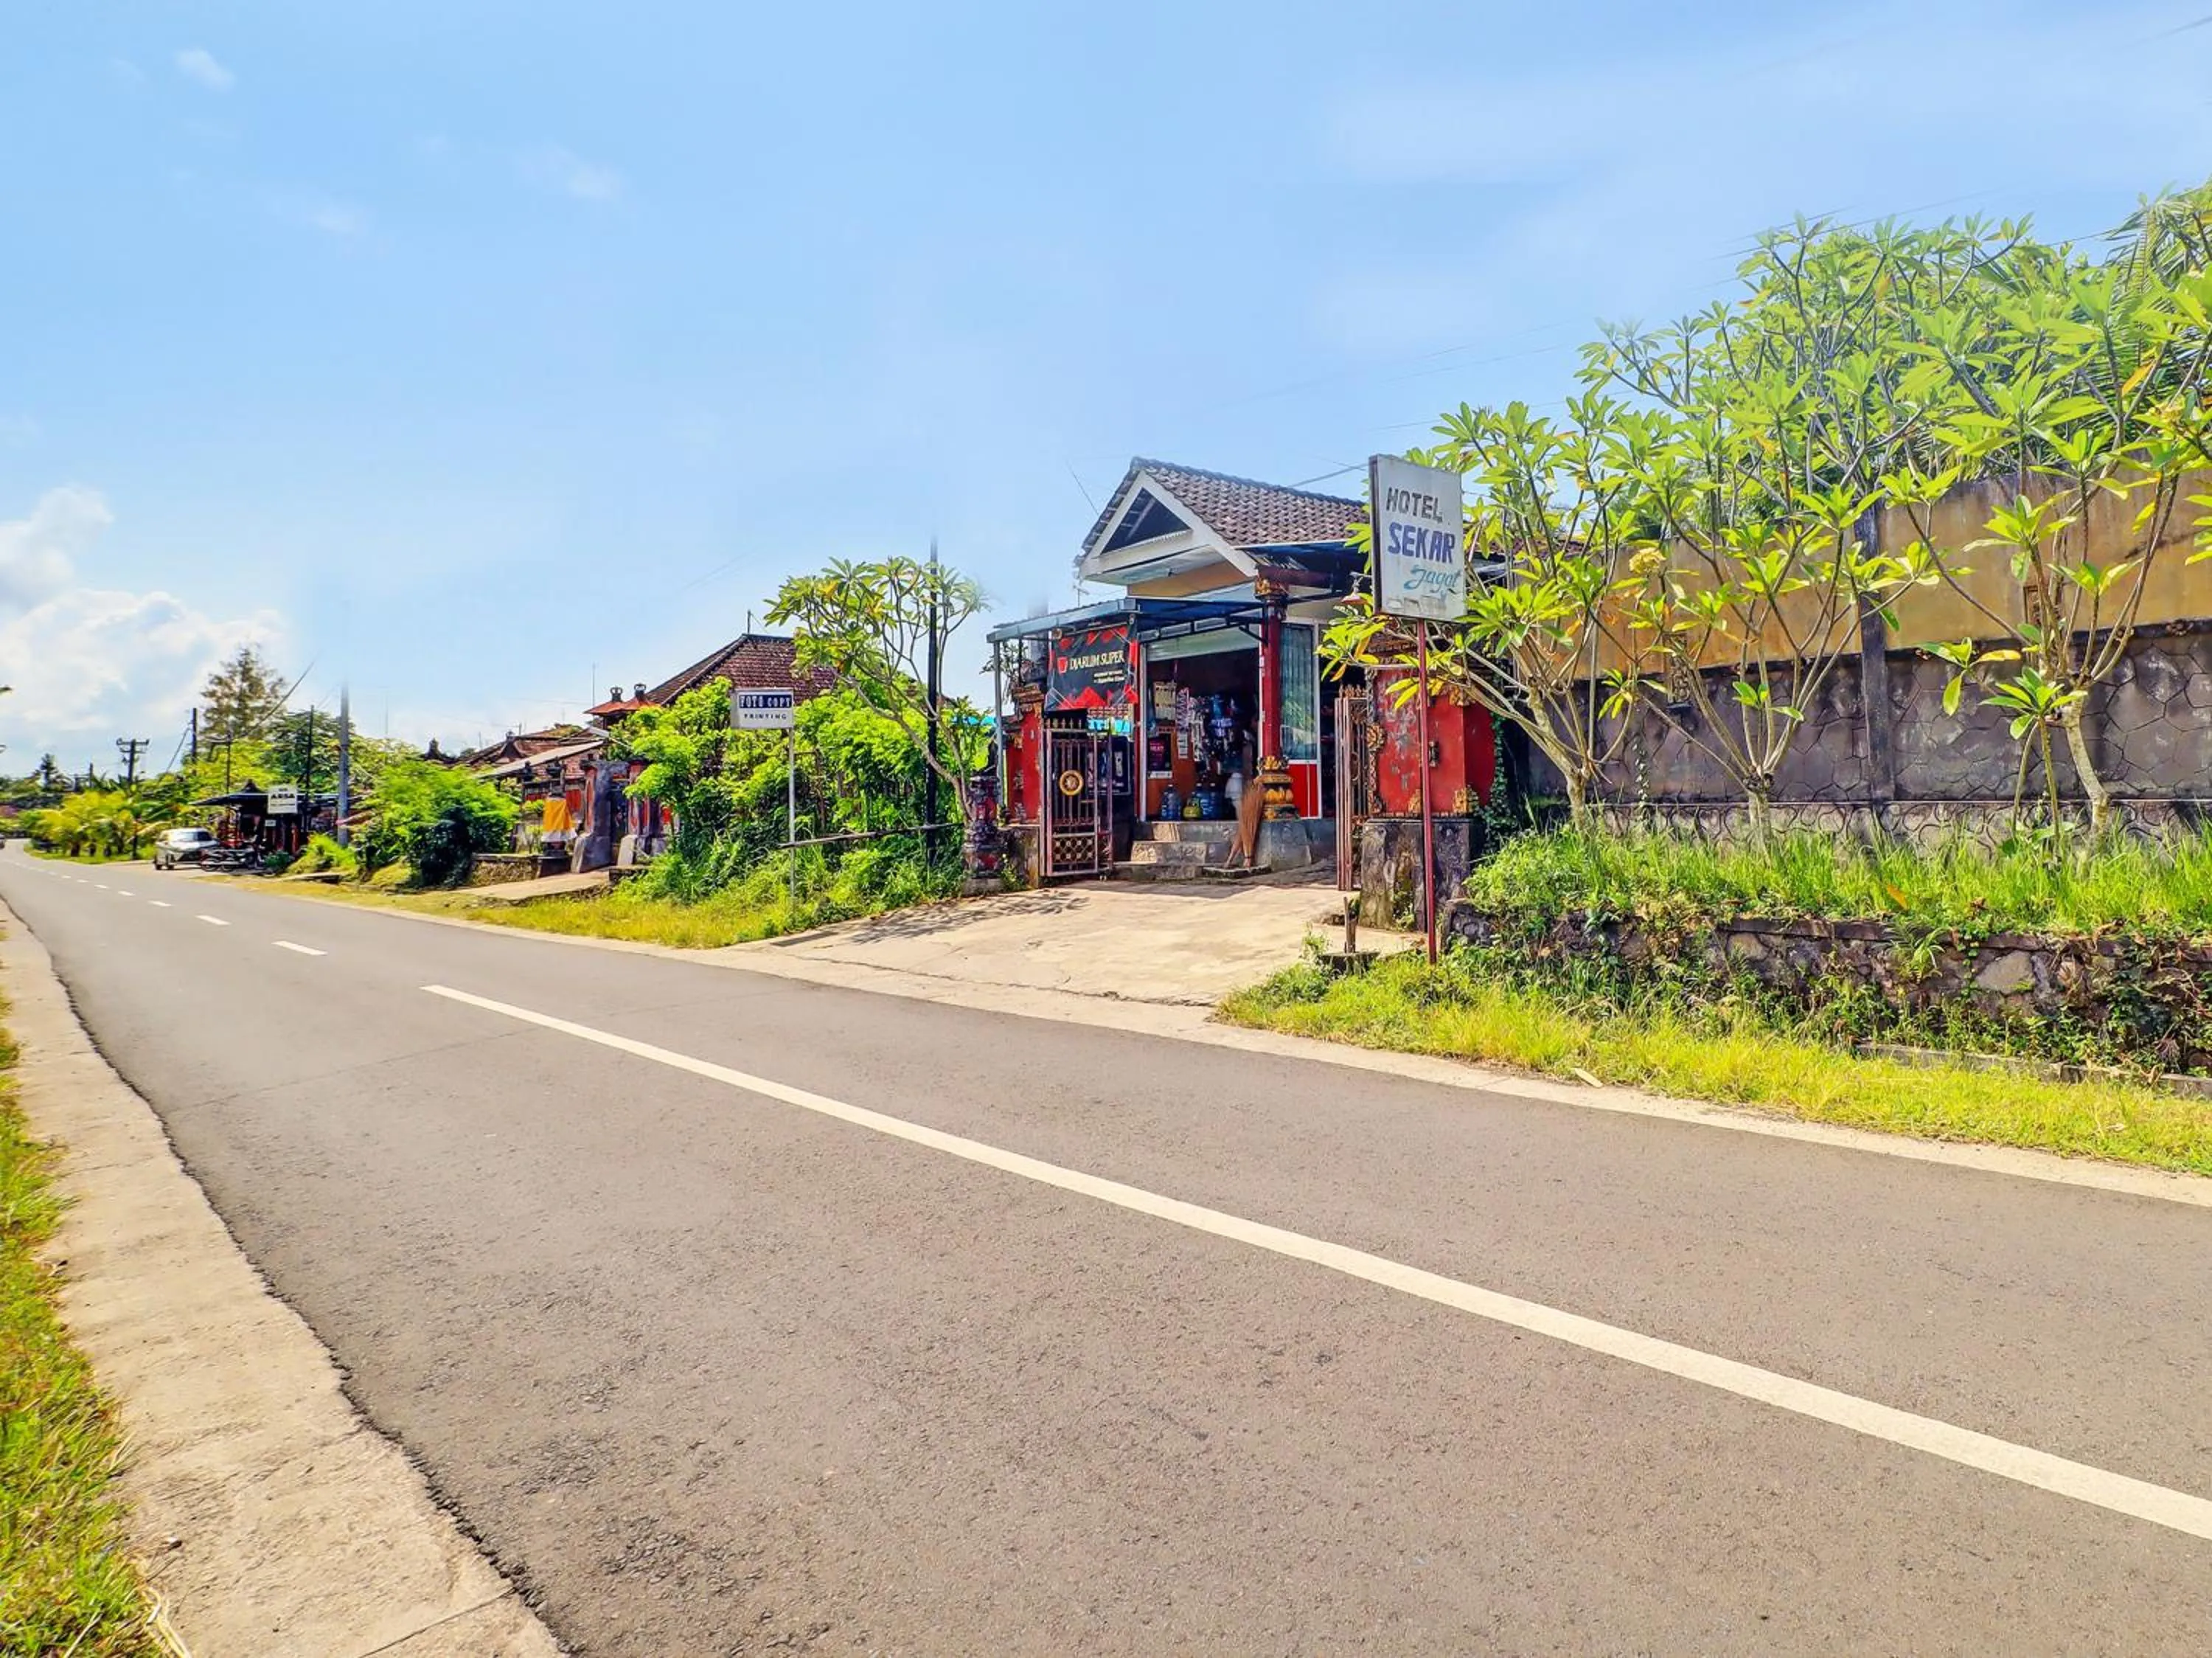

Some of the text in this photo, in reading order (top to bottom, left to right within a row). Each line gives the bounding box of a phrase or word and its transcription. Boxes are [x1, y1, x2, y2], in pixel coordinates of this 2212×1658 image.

[1386, 488, 1442, 523] HOTEL
[1388, 522, 1455, 563] SEKAR
[1100, 650, 1125, 665] SUPER
[740, 696, 763, 707] FOTO
